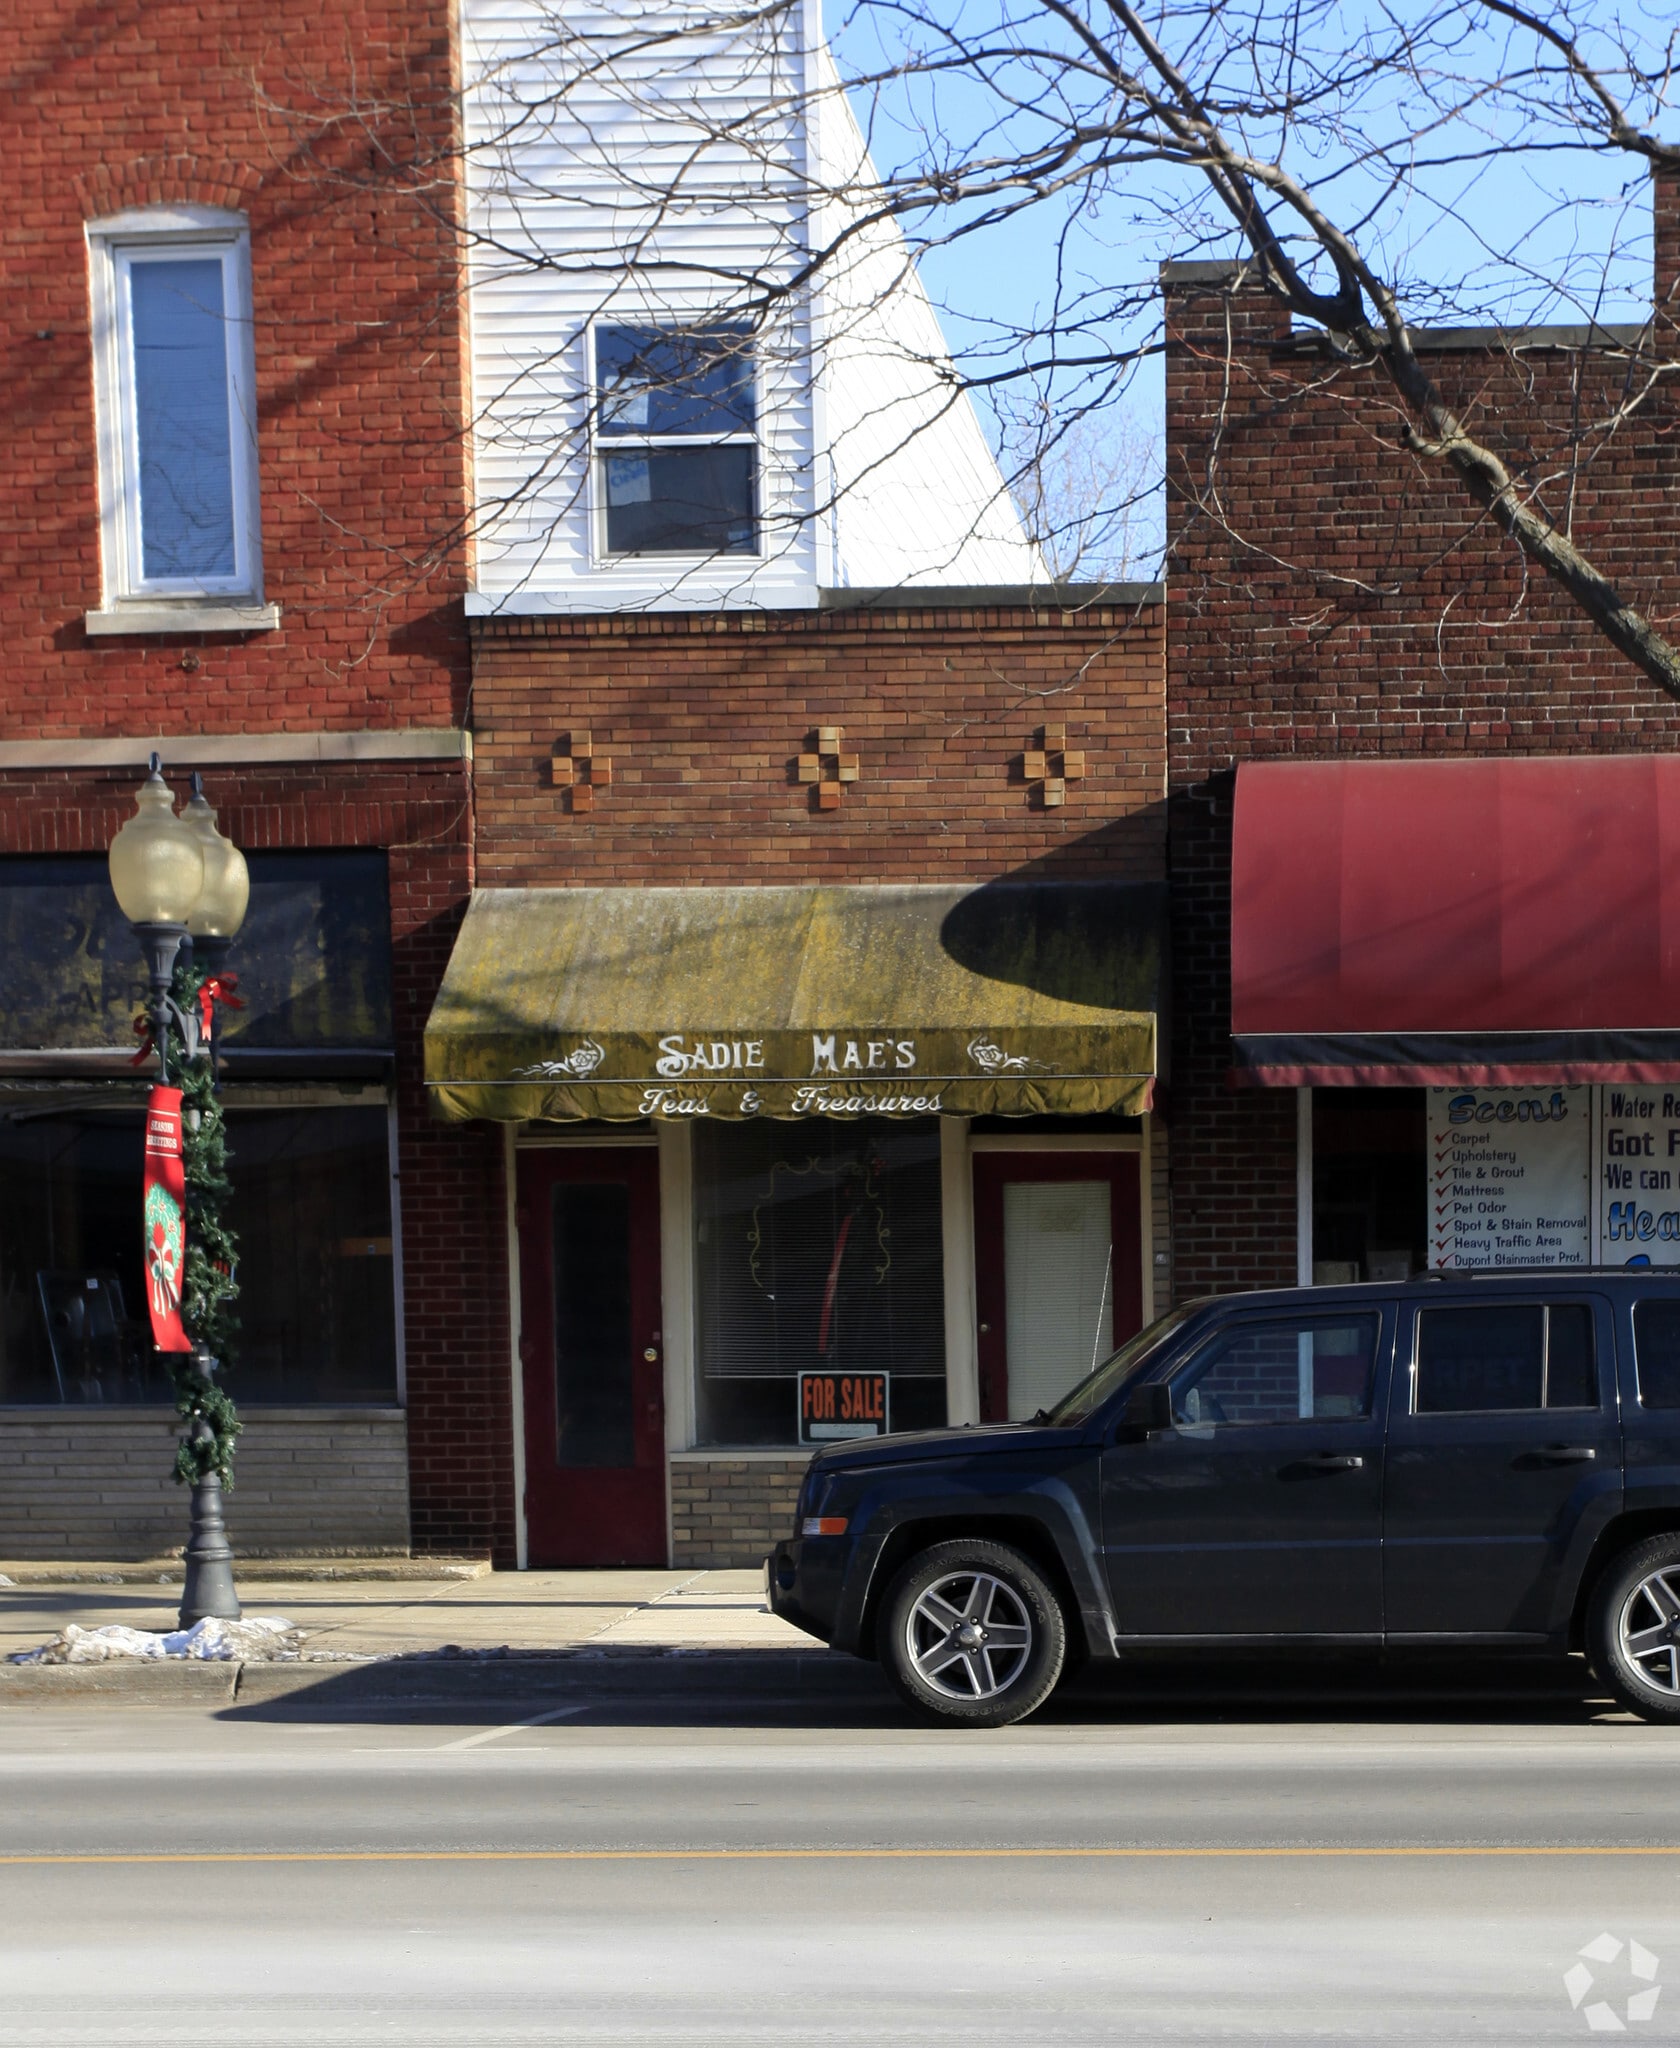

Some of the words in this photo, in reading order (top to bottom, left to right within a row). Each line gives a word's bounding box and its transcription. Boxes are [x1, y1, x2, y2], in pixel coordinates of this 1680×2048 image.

[656, 1035, 765, 1077] SADIE
[811, 1034, 917, 1076] MAE'S
[638, 1088, 710, 1114] Teas
[740, 1091, 764, 1112] &
[791, 1086, 943, 1112] Treasures
[1448, 1092, 1568, 1124] Scent
[1611, 1092, 1655, 1118] Water
[1451, 1133, 1490, 1146] Carpet
[1608, 1129, 1655, 1156] Got
[1452, 1150, 1516, 1164] Upholstery
[1452, 1167, 1471, 1179] Tile
[1476, 1167, 1486, 1178] &
[1491, 1167, 1525, 1178] Grout
[1606, 1164, 1632, 1189] We
[1640, 1170, 1671, 1189] can
[1452, 1185, 1504, 1196] Mattress
[1454, 1202, 1473, 1214] Pet
[1478, 1201, 1507, 1213] Odor
[1454, 1220, 1482, 1234] Spot
[1486, 1219, 1497, 1231] &
[1502, 1218, 1532, 1230] Stain
[1537, 1216, 1587, 1229] Removal
[1608, 1200, 1680, 1241] Hea
[1454, 1237, 1490, 1251] Heavy
[1495, 1235, 1531, 1247] Traffic
[1536, 1235, 1562, 1246] Area
[1455, 1254, 1490, 1268] Dupont
[1495, 1252, 1555, 1265] Stainmaster
[1558, 1251, 1584, 1263] Prot.
[803, 1377, 835, 1419] FOR
[841, 1377, 884, 1419] SALE
